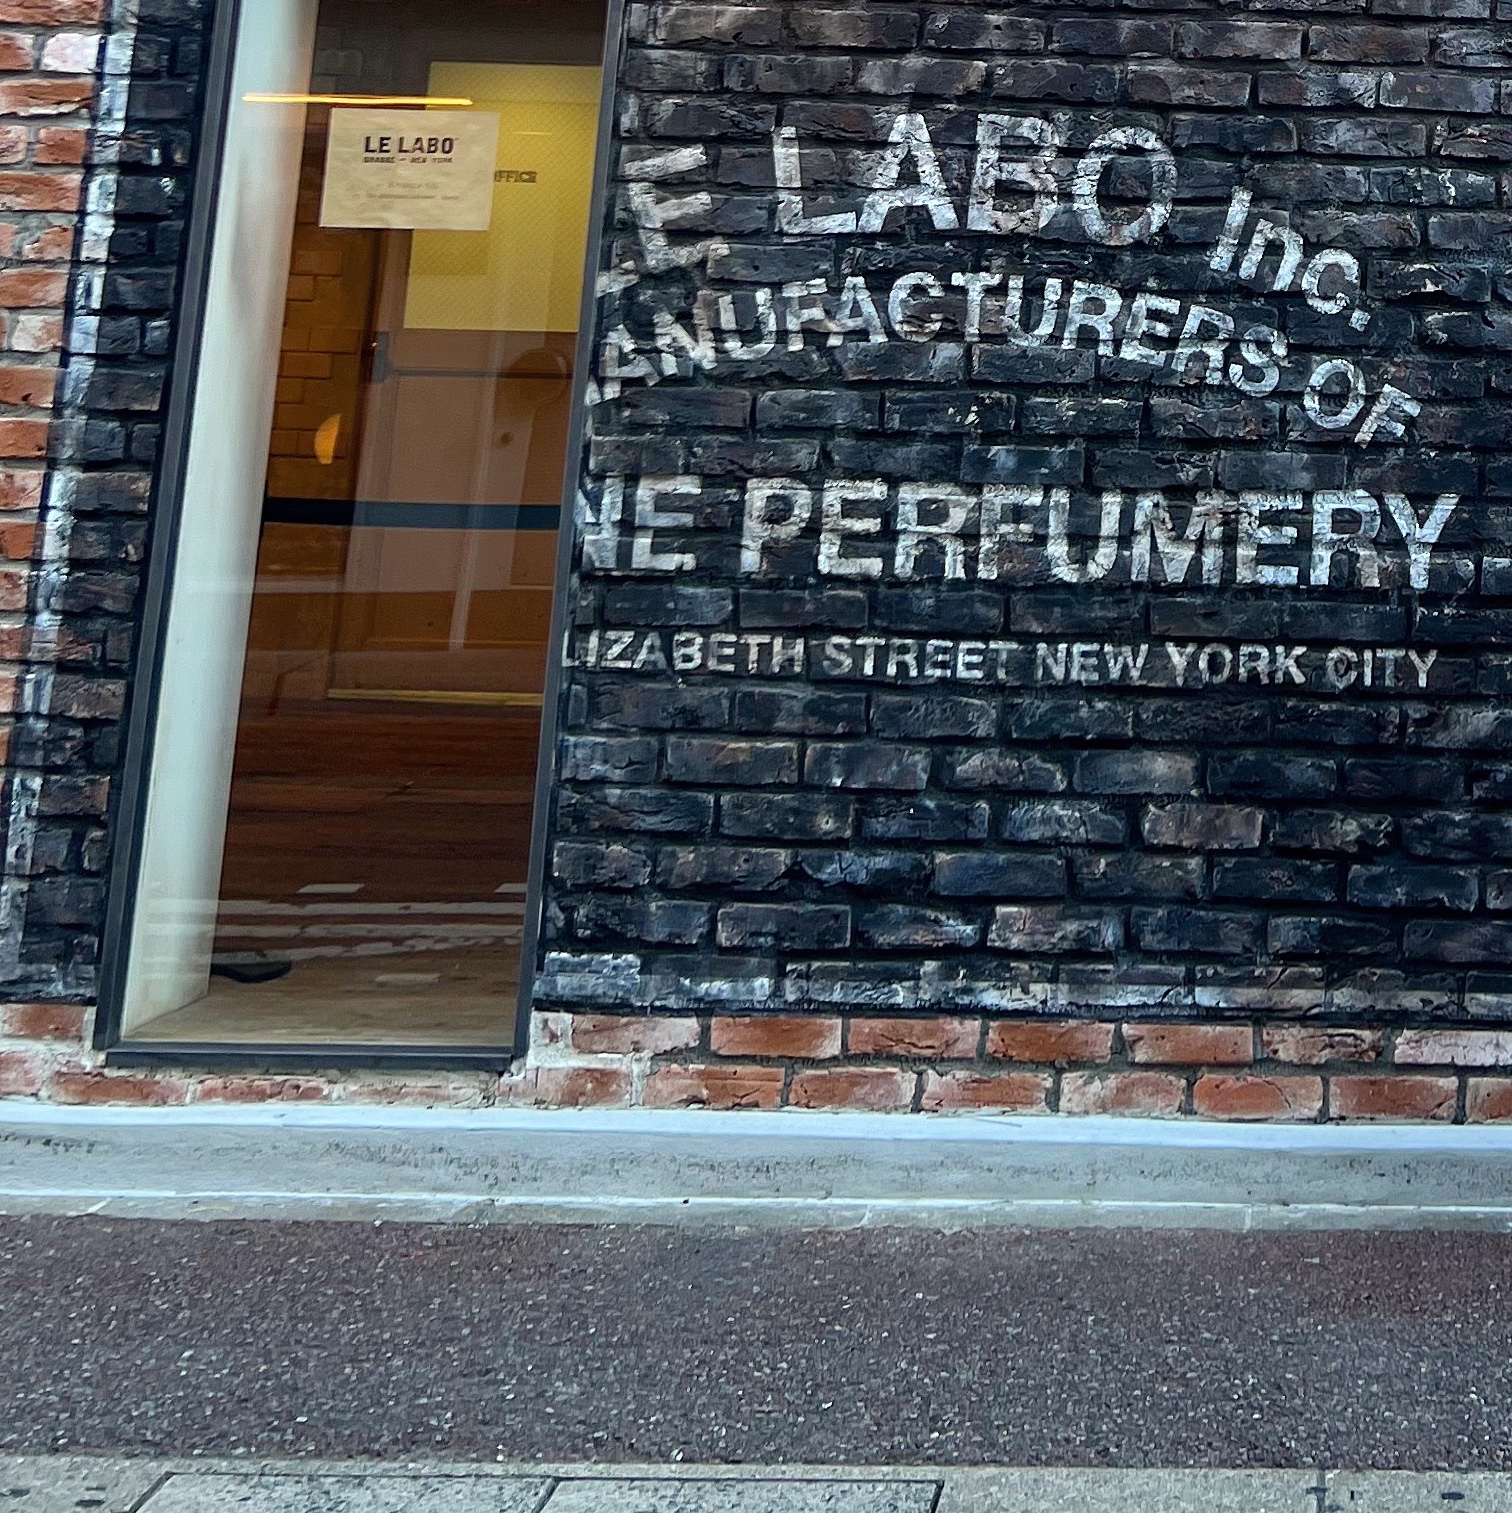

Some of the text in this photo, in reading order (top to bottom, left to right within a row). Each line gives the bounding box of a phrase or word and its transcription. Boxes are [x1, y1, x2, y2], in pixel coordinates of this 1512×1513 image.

[364, 135, 455, 155] LE LABO
[494, 169, 538, 183] FFICE
[771, 112, 1178, 246] LABO
[1210, 185, 1372, 331] Inc.
[584, 272, 1422, 450] ANUFACTURERS OF
[738, 477, 1460, 590] PERFUMERY
[822, 635, 1022, 680] STREET
[1036, 641, 1149, 685] NEW
[1165, 641, 1308, 687] YORK
[1325, 646, 1438, 689] CITY
